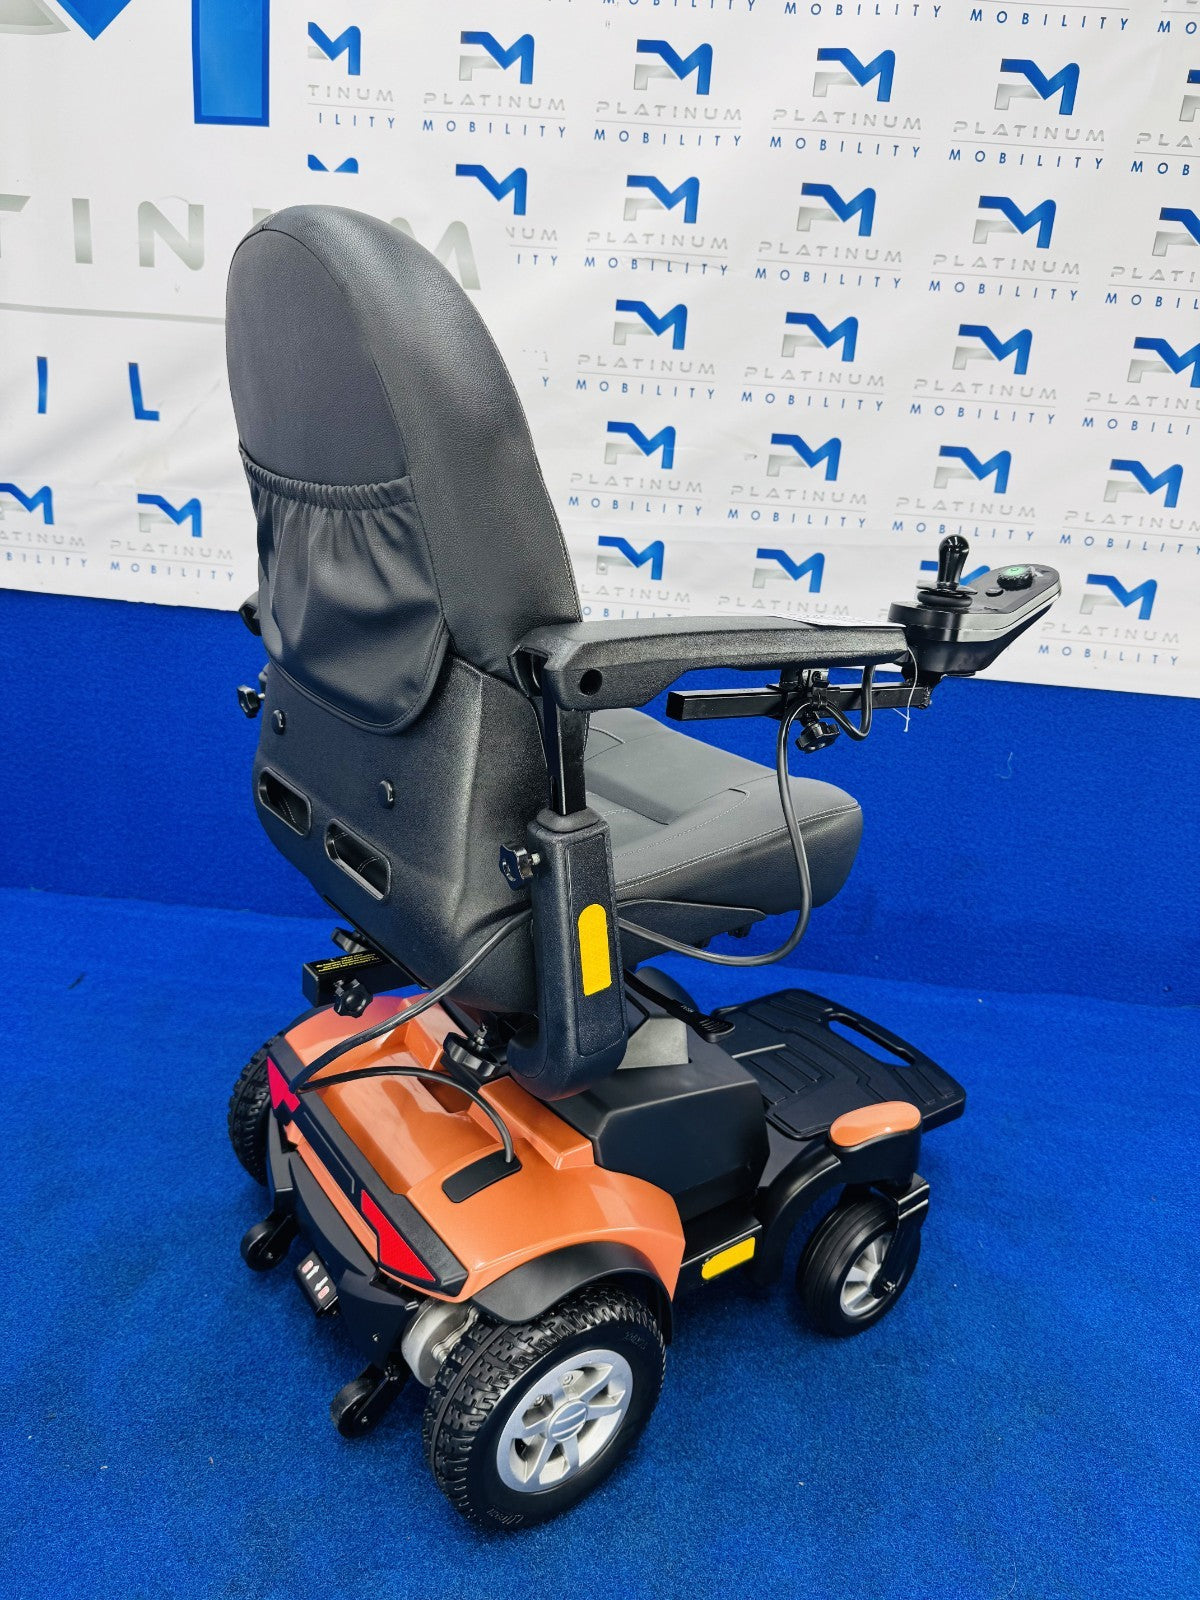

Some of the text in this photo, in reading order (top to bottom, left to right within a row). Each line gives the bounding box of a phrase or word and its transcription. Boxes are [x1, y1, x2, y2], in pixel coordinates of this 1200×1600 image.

[784, 2, 941, 18] MOBILITY
[969, 9, 1128, 30] MOBILITY
[1157, 20, 1197, 35] MO
[308, 85, 393, 102] TINUM
[424, 93, 565, 113] PLATINUM
[319, 112, 395, 129] ILITY
[596, 101, 741, 120] PLATINUM
[773, 109, 921, 131] PLATINUM
[422, 118, 566, 138] MOBILITY
[594, 129, 741, 146] MOBILITY
[953, 121, 1104, 141] PLATINUM
[770, 136, 920, 158] MOBILITY
[949, 149, 1103, 169] MOBILITY
[1130, 161, 1190, 176] MOB
[588, 232, 727, 249] PLATINUM
[517, 253, 558, 266] ITY
[759, 241, 901, 264] PLATINUM
[584, 255, 728, 276] MOBILITY
[933, 254, 1079, 275] PLATINUM
[1111, 266, 1195, 283] PLATI
[755, 267, 901, 289] MOBILITY
[929, 280, 1078, 301] MOBILITY
[1105, 292, 1199, 310] MOBIL
[578, 354, 714, 375] PLATINUM
[745, 367, 884, 388] PLATINUM
[576, 377, 715, 399] MOBILITY
[914, 379, 1056, 401] PLATINUM
[741, 391, 883, 411] MOBILITY
[910, 402, 1055, 424] MOBILITY
[1082, 417, 1190, 435] MOBILI
[571, 473, 701, 492] PLATINUM
[568, 495, 702, 516] MOBILITY
[731, 486, 866, 506] PLATINUM
[896, 497, 1035, 517] PLATINUM
[728, 507, 866, 528] MOBILITY
[892, 521, 1034, 541] MOBILITY
[109, 539, 233, 560] PLATINUM
[110, 561, 233, 581] MOBILITY
[718, 596, 851, 616] PLATINUM
[1042, 622, 1180, 643] PLATINUM
[1038, 644, 1178, 665] MOBILITY
